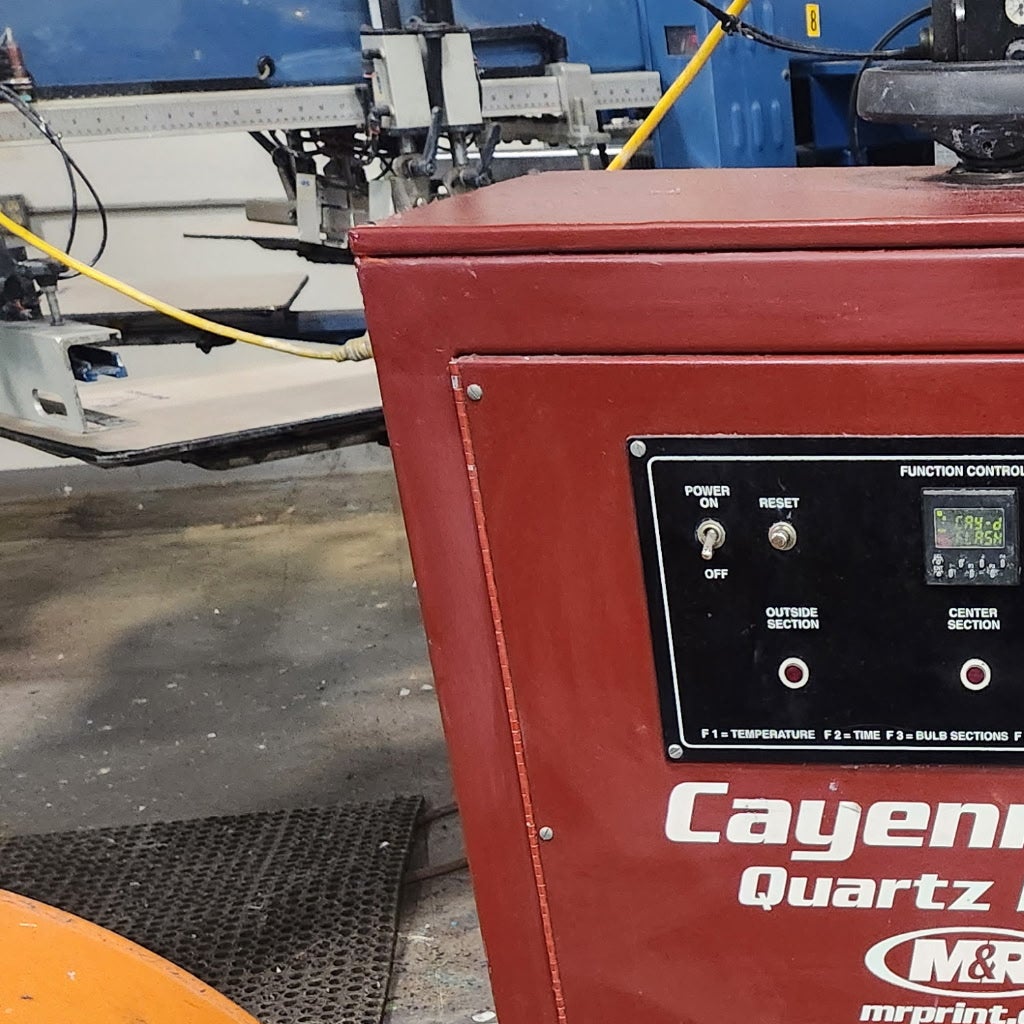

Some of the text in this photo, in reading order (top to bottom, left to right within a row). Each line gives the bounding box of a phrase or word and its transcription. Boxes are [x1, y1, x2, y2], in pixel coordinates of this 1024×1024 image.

[810, 9, 817, 32] 8
[900, 465, 964, 478] FUNCTION
[684, 485, 731, 497] POWER
[699, 497, 719, 509] ON
[758, 498, 800, 510] RESET
[704, 568, 729, 580] OFF
[765, 606, 819, 618] OUTSIDE
[948, 607, 998, 618] CENTER
[766, 618, 820, 630] SECTION
[947, 619, 1001, 631] SECTION
[730, 729, 816, 740] TEMPERATURE
[852, 729, 881, 741] TIME
[915, 730, 948, 741] BULB
[949, 730, 1009, 742] SECTIONS
[738, 866, 995, 912] Quartz
